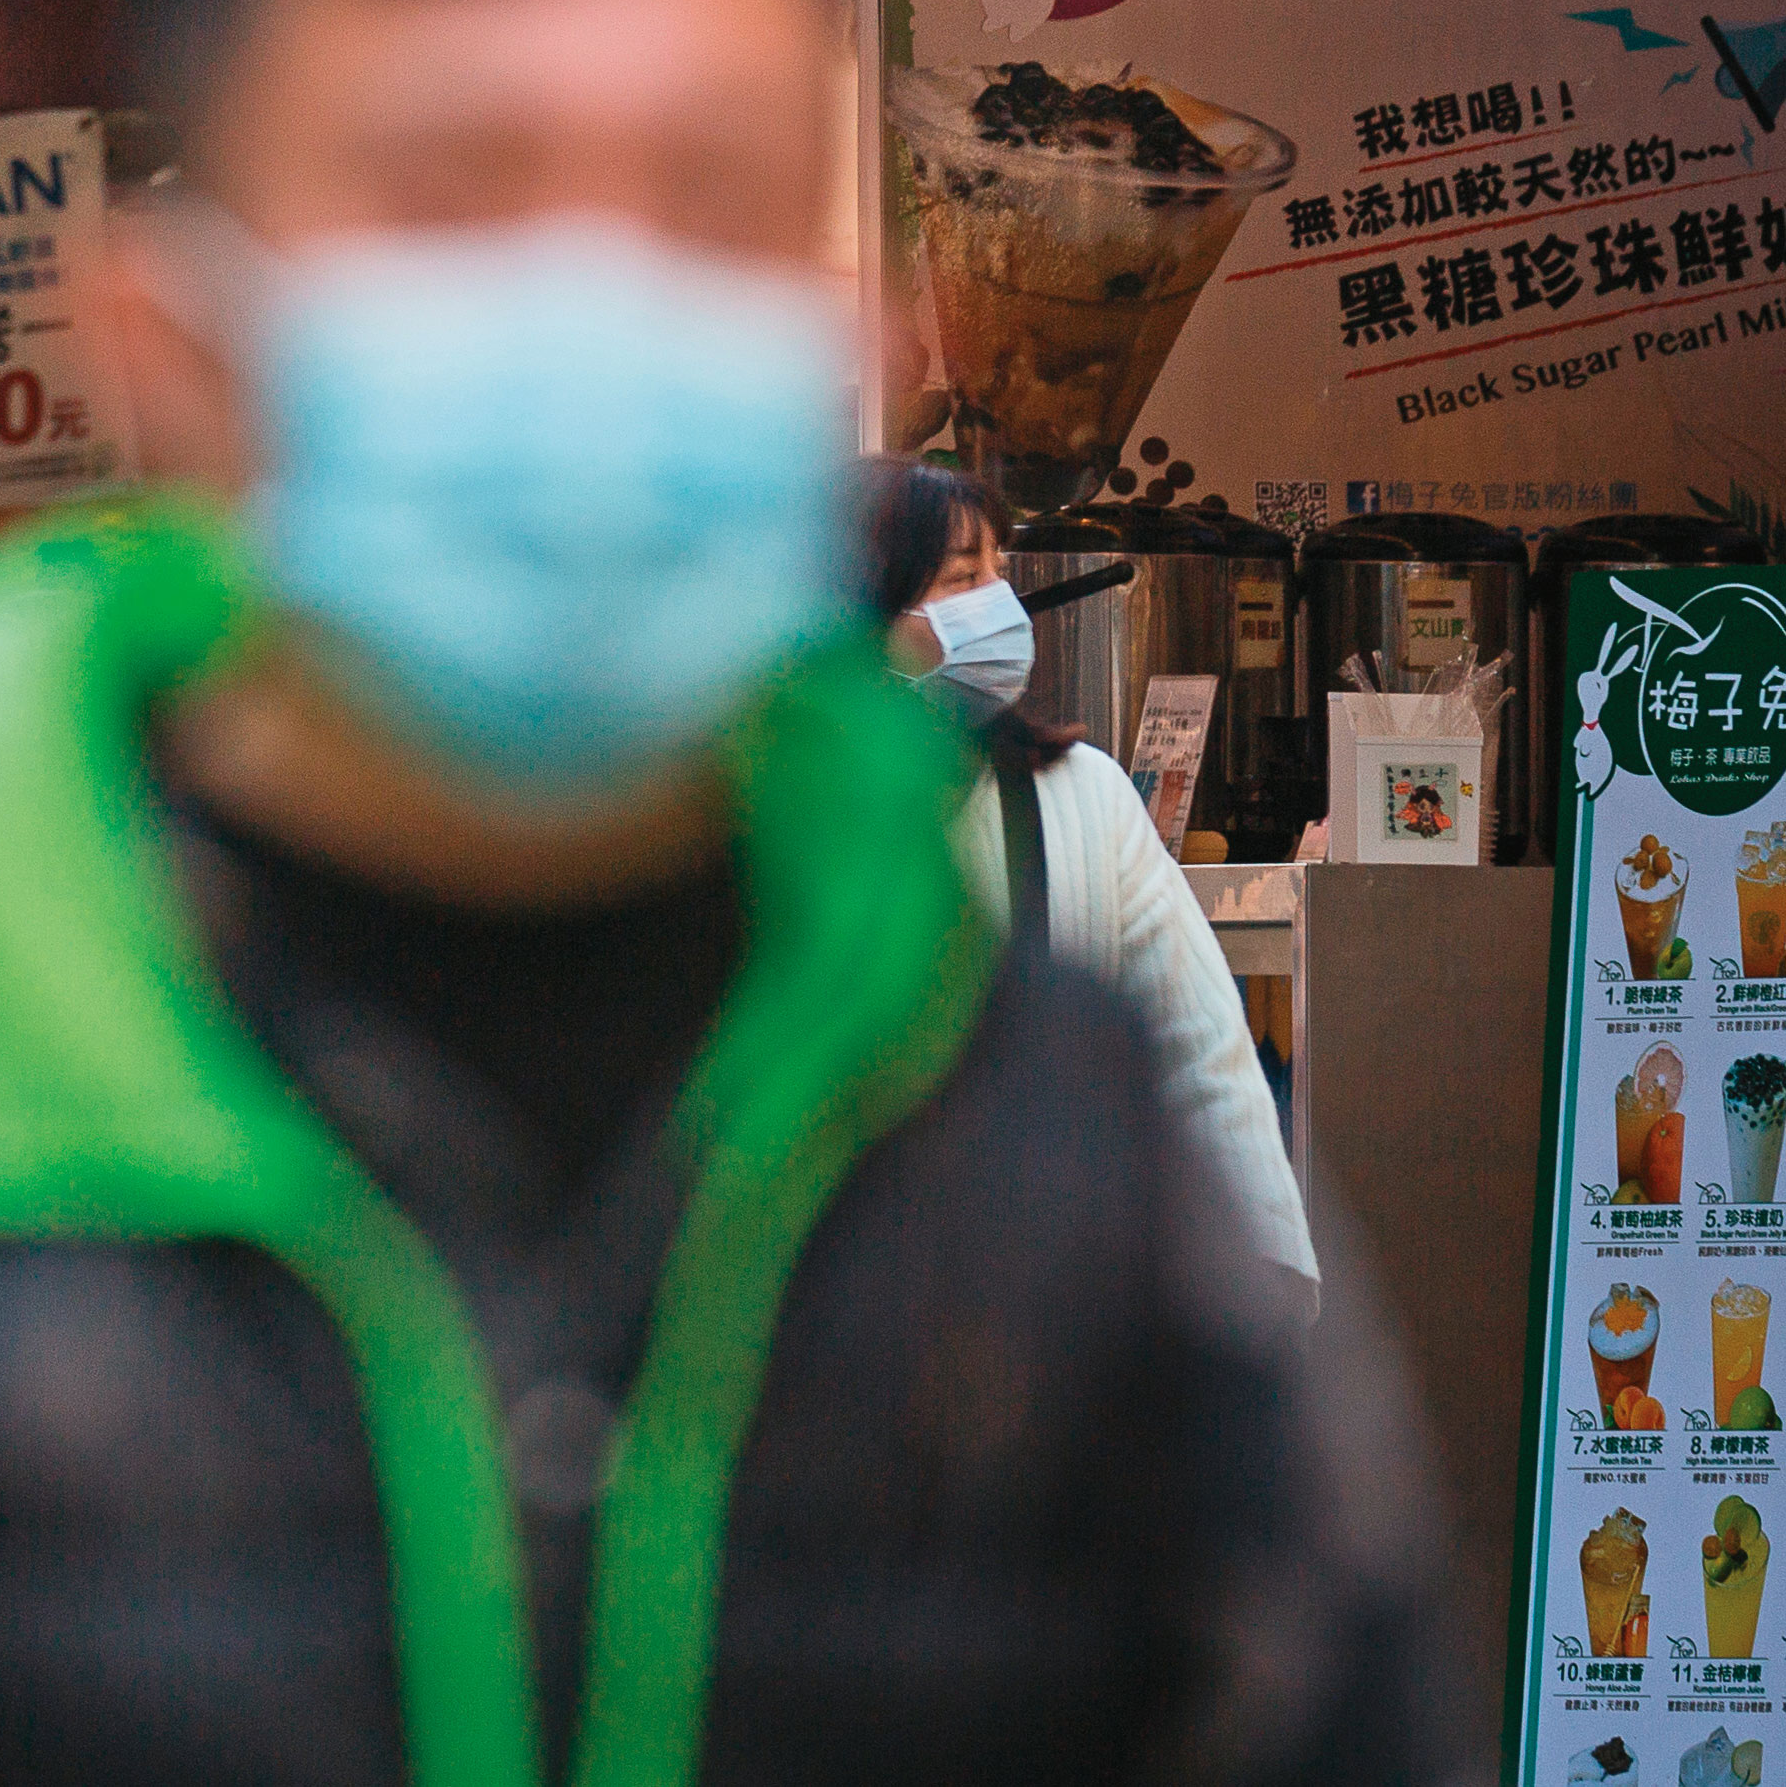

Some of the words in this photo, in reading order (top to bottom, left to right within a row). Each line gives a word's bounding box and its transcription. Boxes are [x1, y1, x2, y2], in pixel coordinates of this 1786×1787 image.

[1353, 80, 1577, 161] 我想喝!!
[1395, 371, 1504, 425] Black
[1512, 343, 1622, 391] Sugar
[1633, 312, 1728, 363] Pearl
[1743, 771, 1770, 784] Shop
